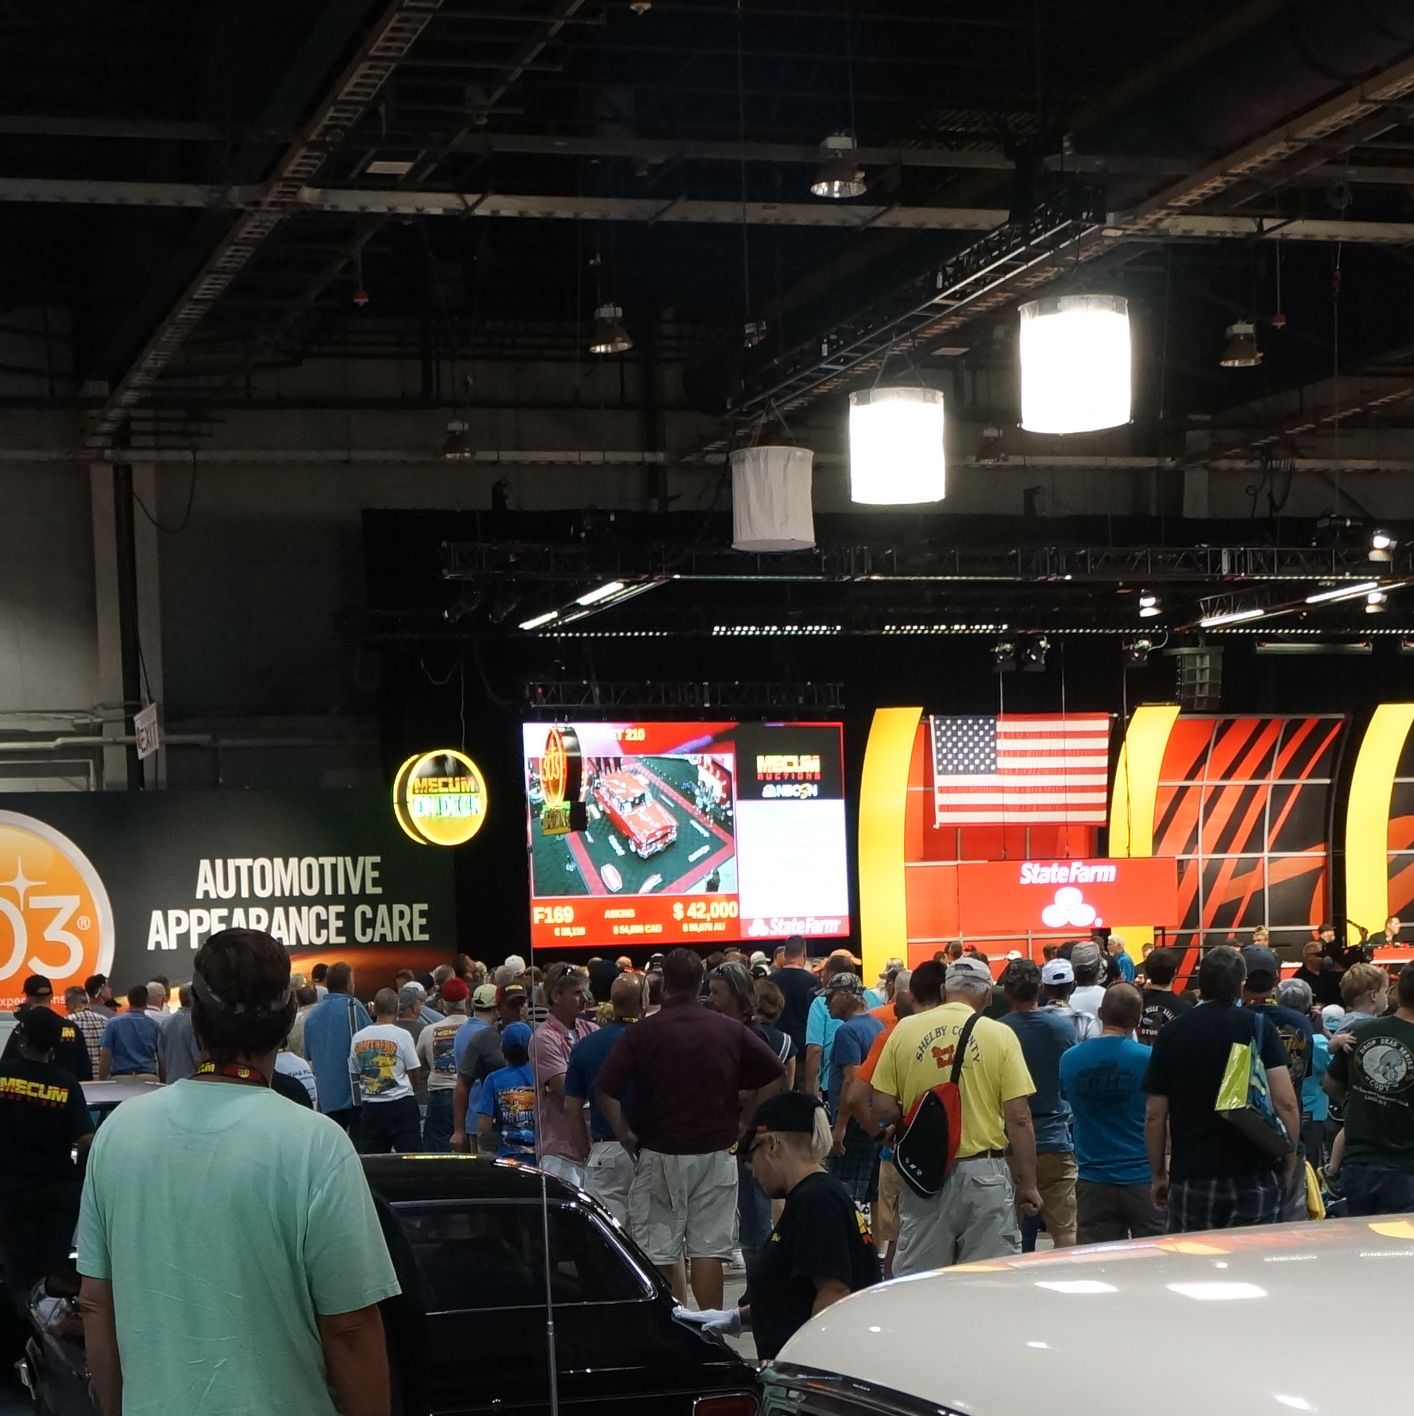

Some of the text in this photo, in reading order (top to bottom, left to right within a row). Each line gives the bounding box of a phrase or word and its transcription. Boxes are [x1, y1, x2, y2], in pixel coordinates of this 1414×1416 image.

[135, 720, 160, 754] EXIT
[757, 755, 820, 773] MECUM
[757, 772, 821, 780] AUCTIONS
[414, 776, 475, 794] MECUM
[413, 796, 437, 816] ON
[196, 856, 382, 899] AUTOMOTIVE
[354, 903, 430, 942] CARE
[534, 906, 574, 924] F169
[687, 901, 738, 921] 42,000
[916, 1025, 947, 1062] SHELBY
[952, 1025, 980, 1063] CONTY
[0, 1077, 68, 1103] MECUM
